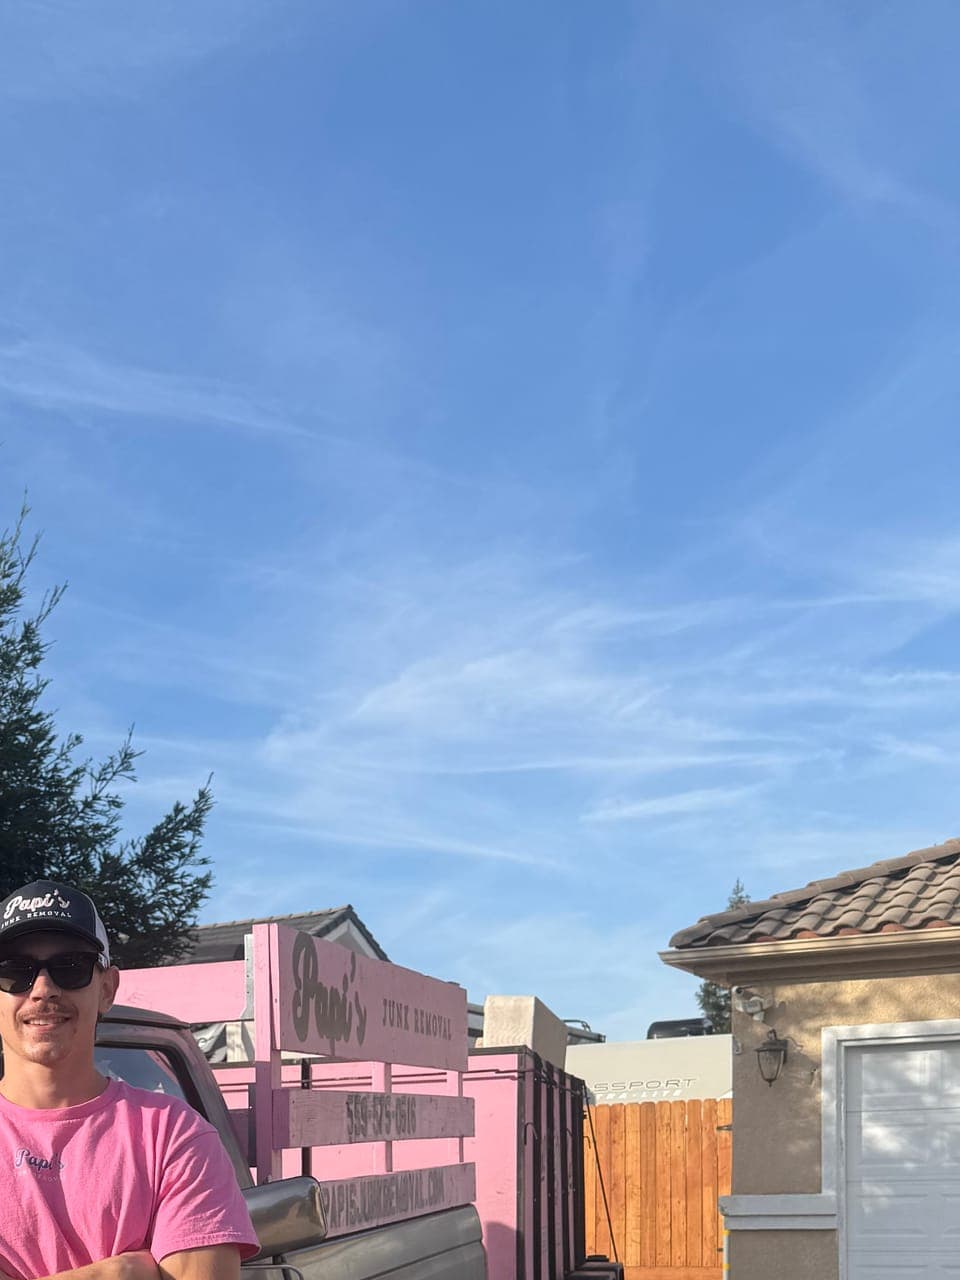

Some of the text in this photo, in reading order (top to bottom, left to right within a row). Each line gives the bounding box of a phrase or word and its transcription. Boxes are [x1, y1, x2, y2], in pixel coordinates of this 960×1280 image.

[4, 888, 70, 919] Papi's
[1, 910, 72, 929] JUNK REMOVAL
[292, 931, 452, 1056] Papi's JUNK REMOVAL
[593, 1079, 697, 1092] SSPORT
[595, 1089, 682, 1100] TRA-LITE
